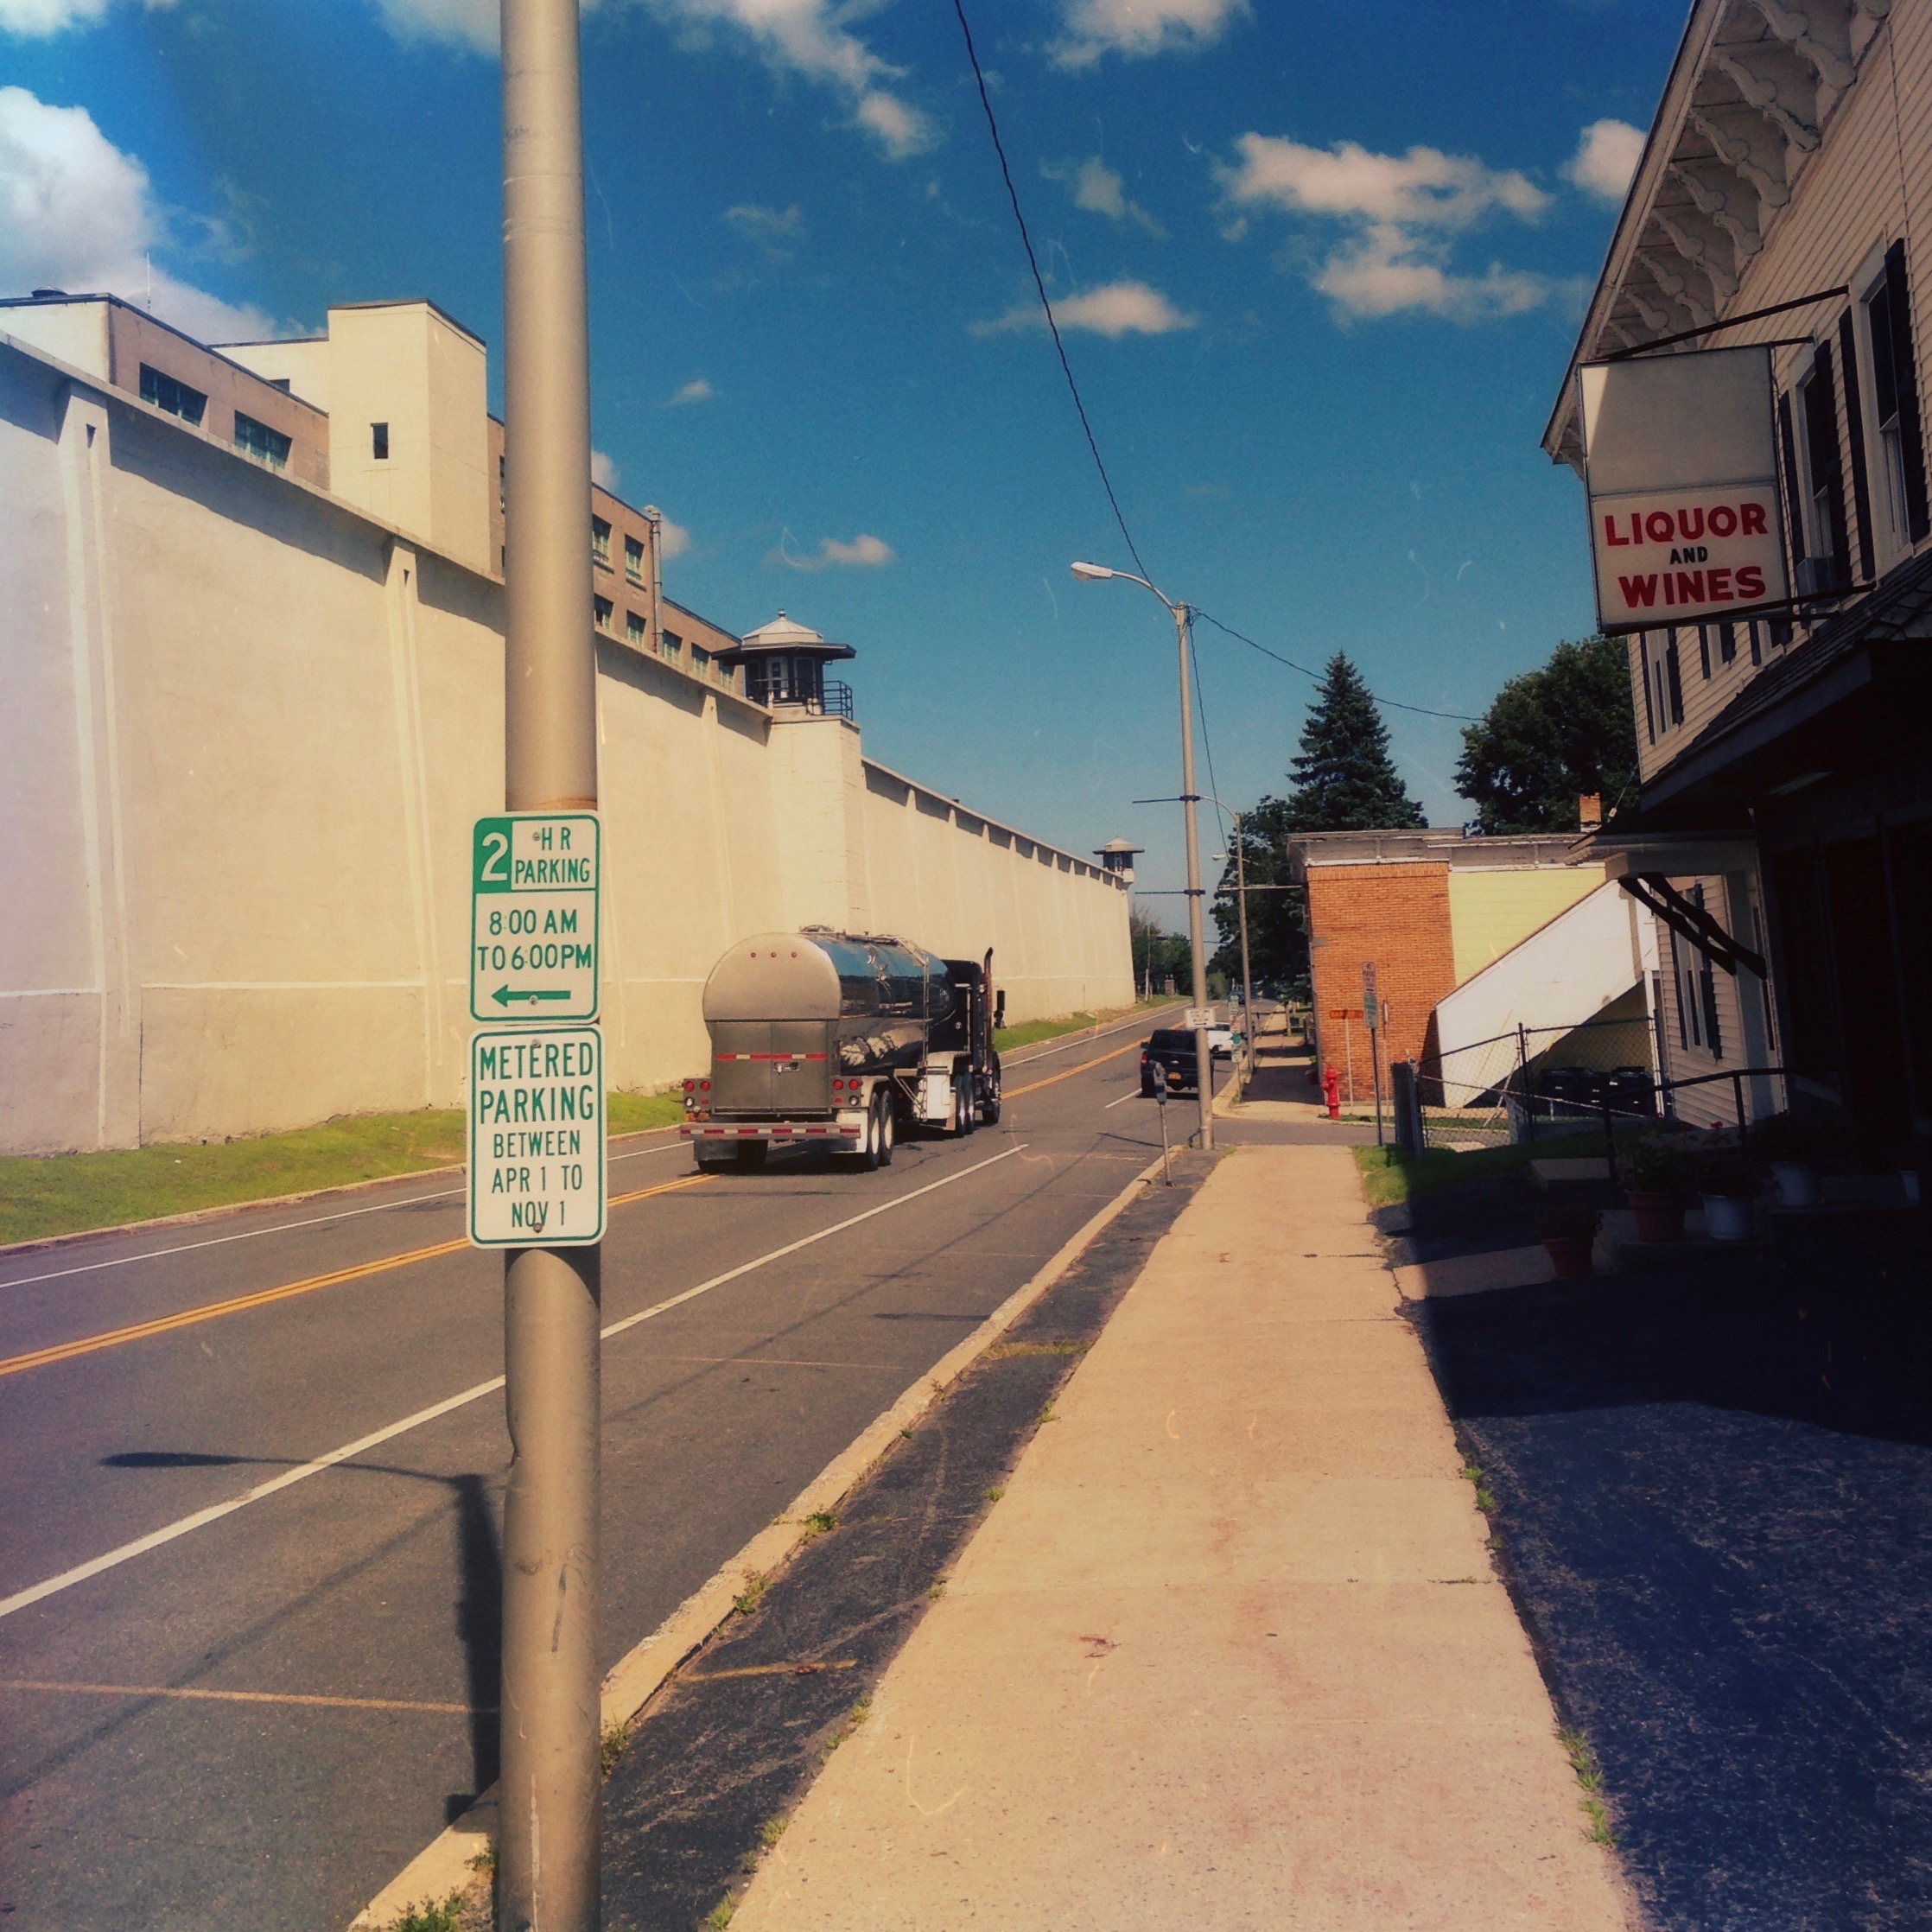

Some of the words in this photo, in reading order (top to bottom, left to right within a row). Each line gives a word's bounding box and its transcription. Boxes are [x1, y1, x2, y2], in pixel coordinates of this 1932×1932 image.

[1605, 502, 1768, 547] LIQUOR
[1669, 545, 1708, 565] AND
[1617, 565, 1766, 608] WINES
[481, 832, 508, 881] 2
[515, 858, 590, 884] PARKING
[543, 909, 577, 934] AM
[477, 945, 506, 971] TO
[480, 1042, 594, 1080] METERED
[480, 1084, 594, 1124] PARKING
[493, 1130, 580, 1158] BETWEEN
[492, 1167, 531, 1193] APR
[541, 1166, 546, 1191] 1
[561, 1164, 582, 1191] TO
[512, 1201, 549, 1228] NOV
[559, 1200, 564, 1225] 1
